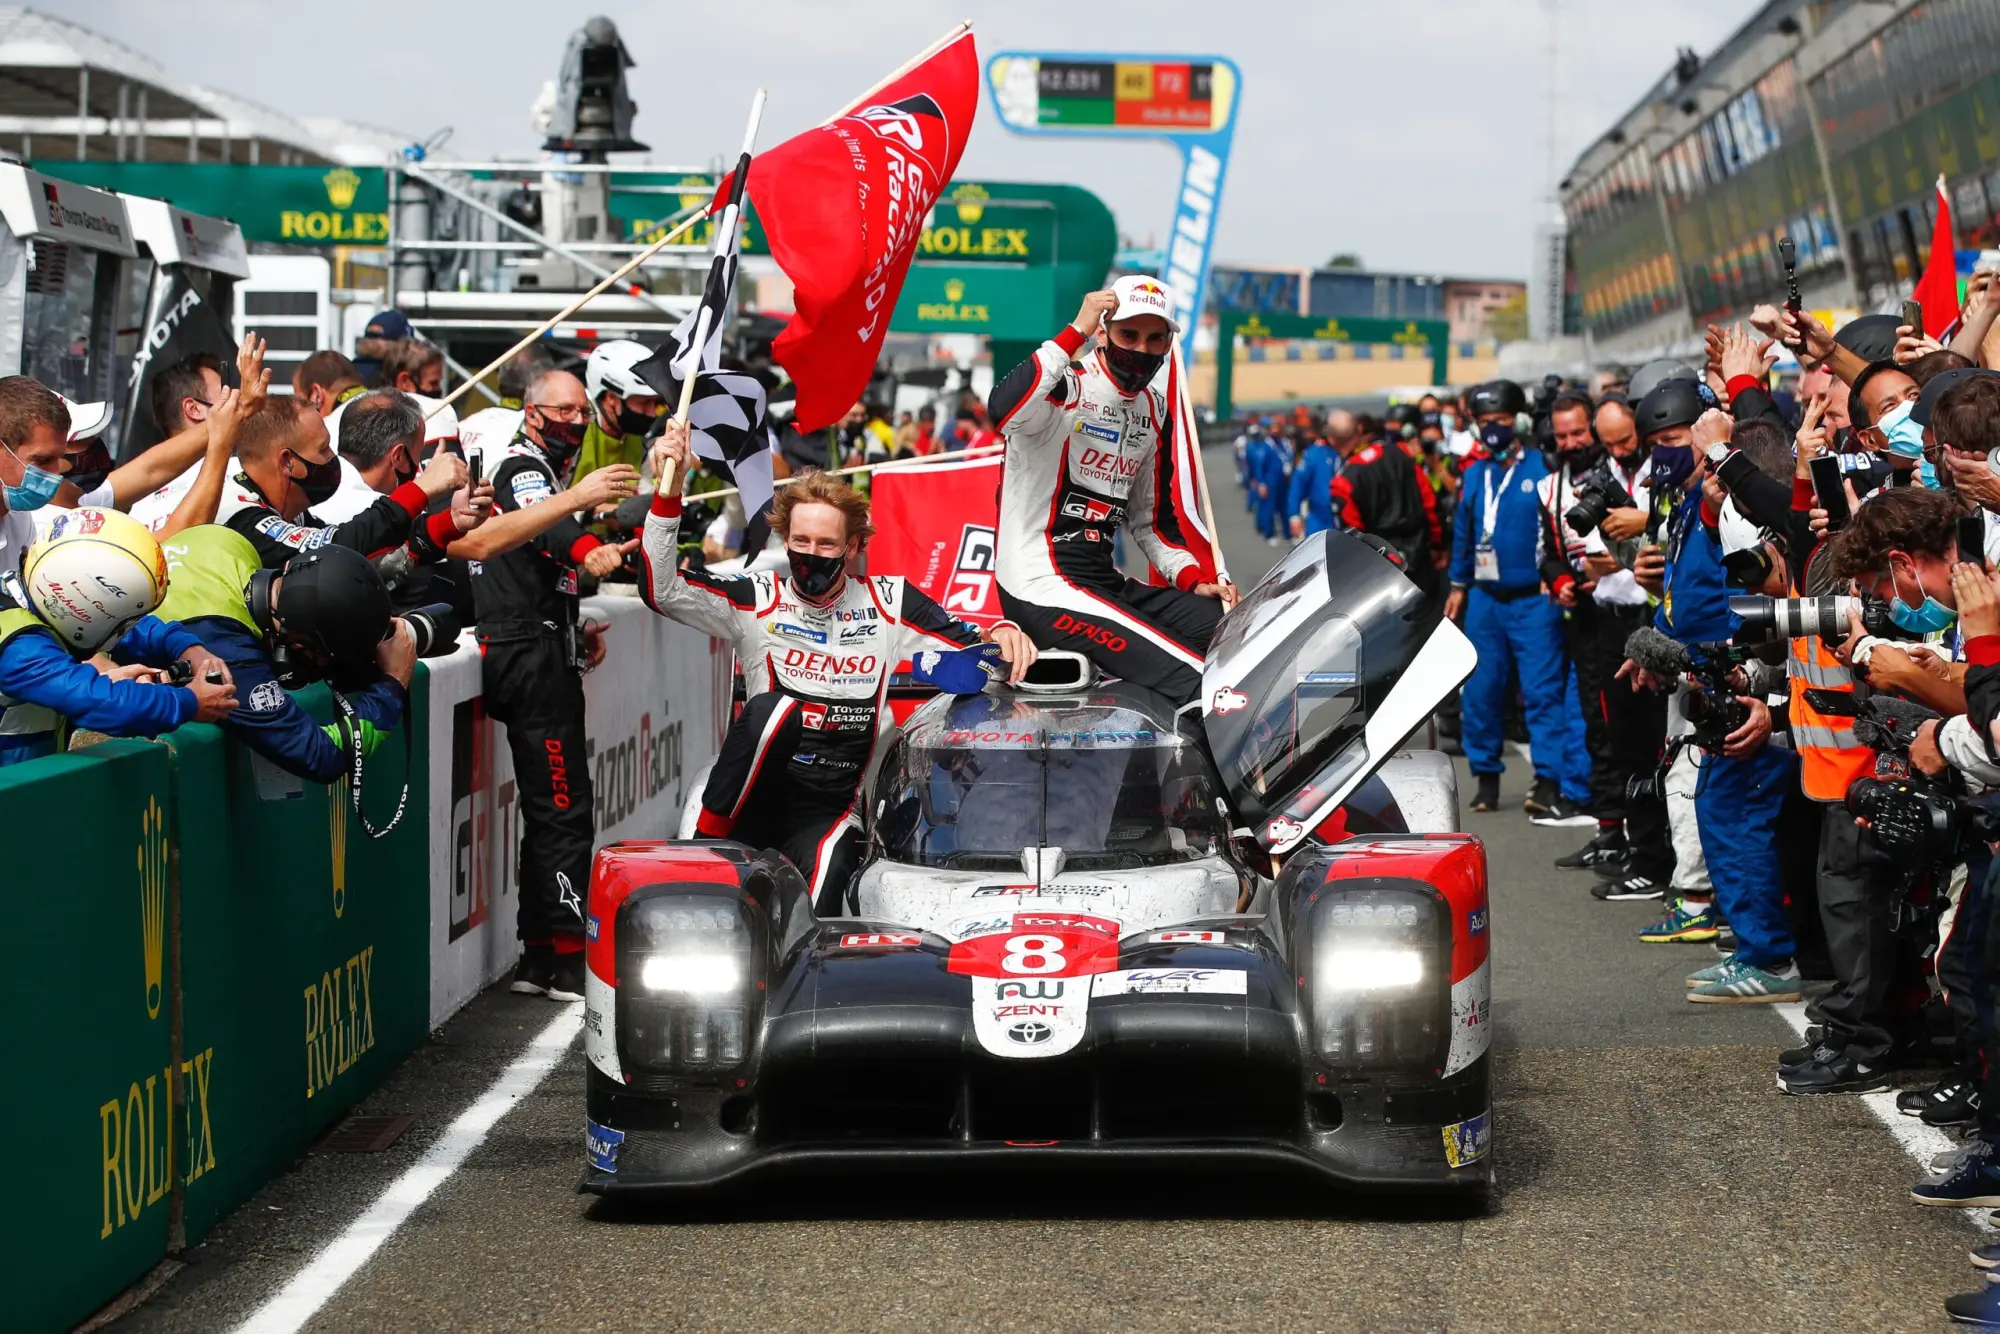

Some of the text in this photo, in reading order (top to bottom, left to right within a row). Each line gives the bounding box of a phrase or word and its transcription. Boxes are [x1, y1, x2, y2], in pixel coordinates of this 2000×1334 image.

[1149, 295, 1166, 310] Bull
[917, 303, 990, 322] ROLEX
[1080, 447, 1139, 477] DENSO
[1079, 466, 1113, 486] TOYOTA
[1064, 503, 1106, 522] GR
[919, 541, 947, 589] Pushing
[947, 530, 996, 612] GR
[778, 602, 798, 613] ENT
[785, 627, 822, 641] MICHELIN
[840, 624, 878, 639] WEC
[1053, 613, 1128, 652] DENSO
[784, 648, 877, 675] DENSO
[783, 667, 827, 683] TOYOTA
[830, 714, 870, 722] GAZOO
[831, 705, 876, 714] TOYOTA
[942, 731, 1034, 744] TOYOTA
[354, 730, 363, 786] PHOTOS
[640, 700, 683, 808] Racing
[545, 739, 570, 809] DENSO
[1017, 917, 1110, 934] TOTAL
[846, 934, 915, 945] HY
[1160, 932, 1213, 941] P1
[1001, 934, 1067, 975] 8
[996, 1005, 1064, 1017] ZENT
[303, 945, 375, 1099] ROLEX
